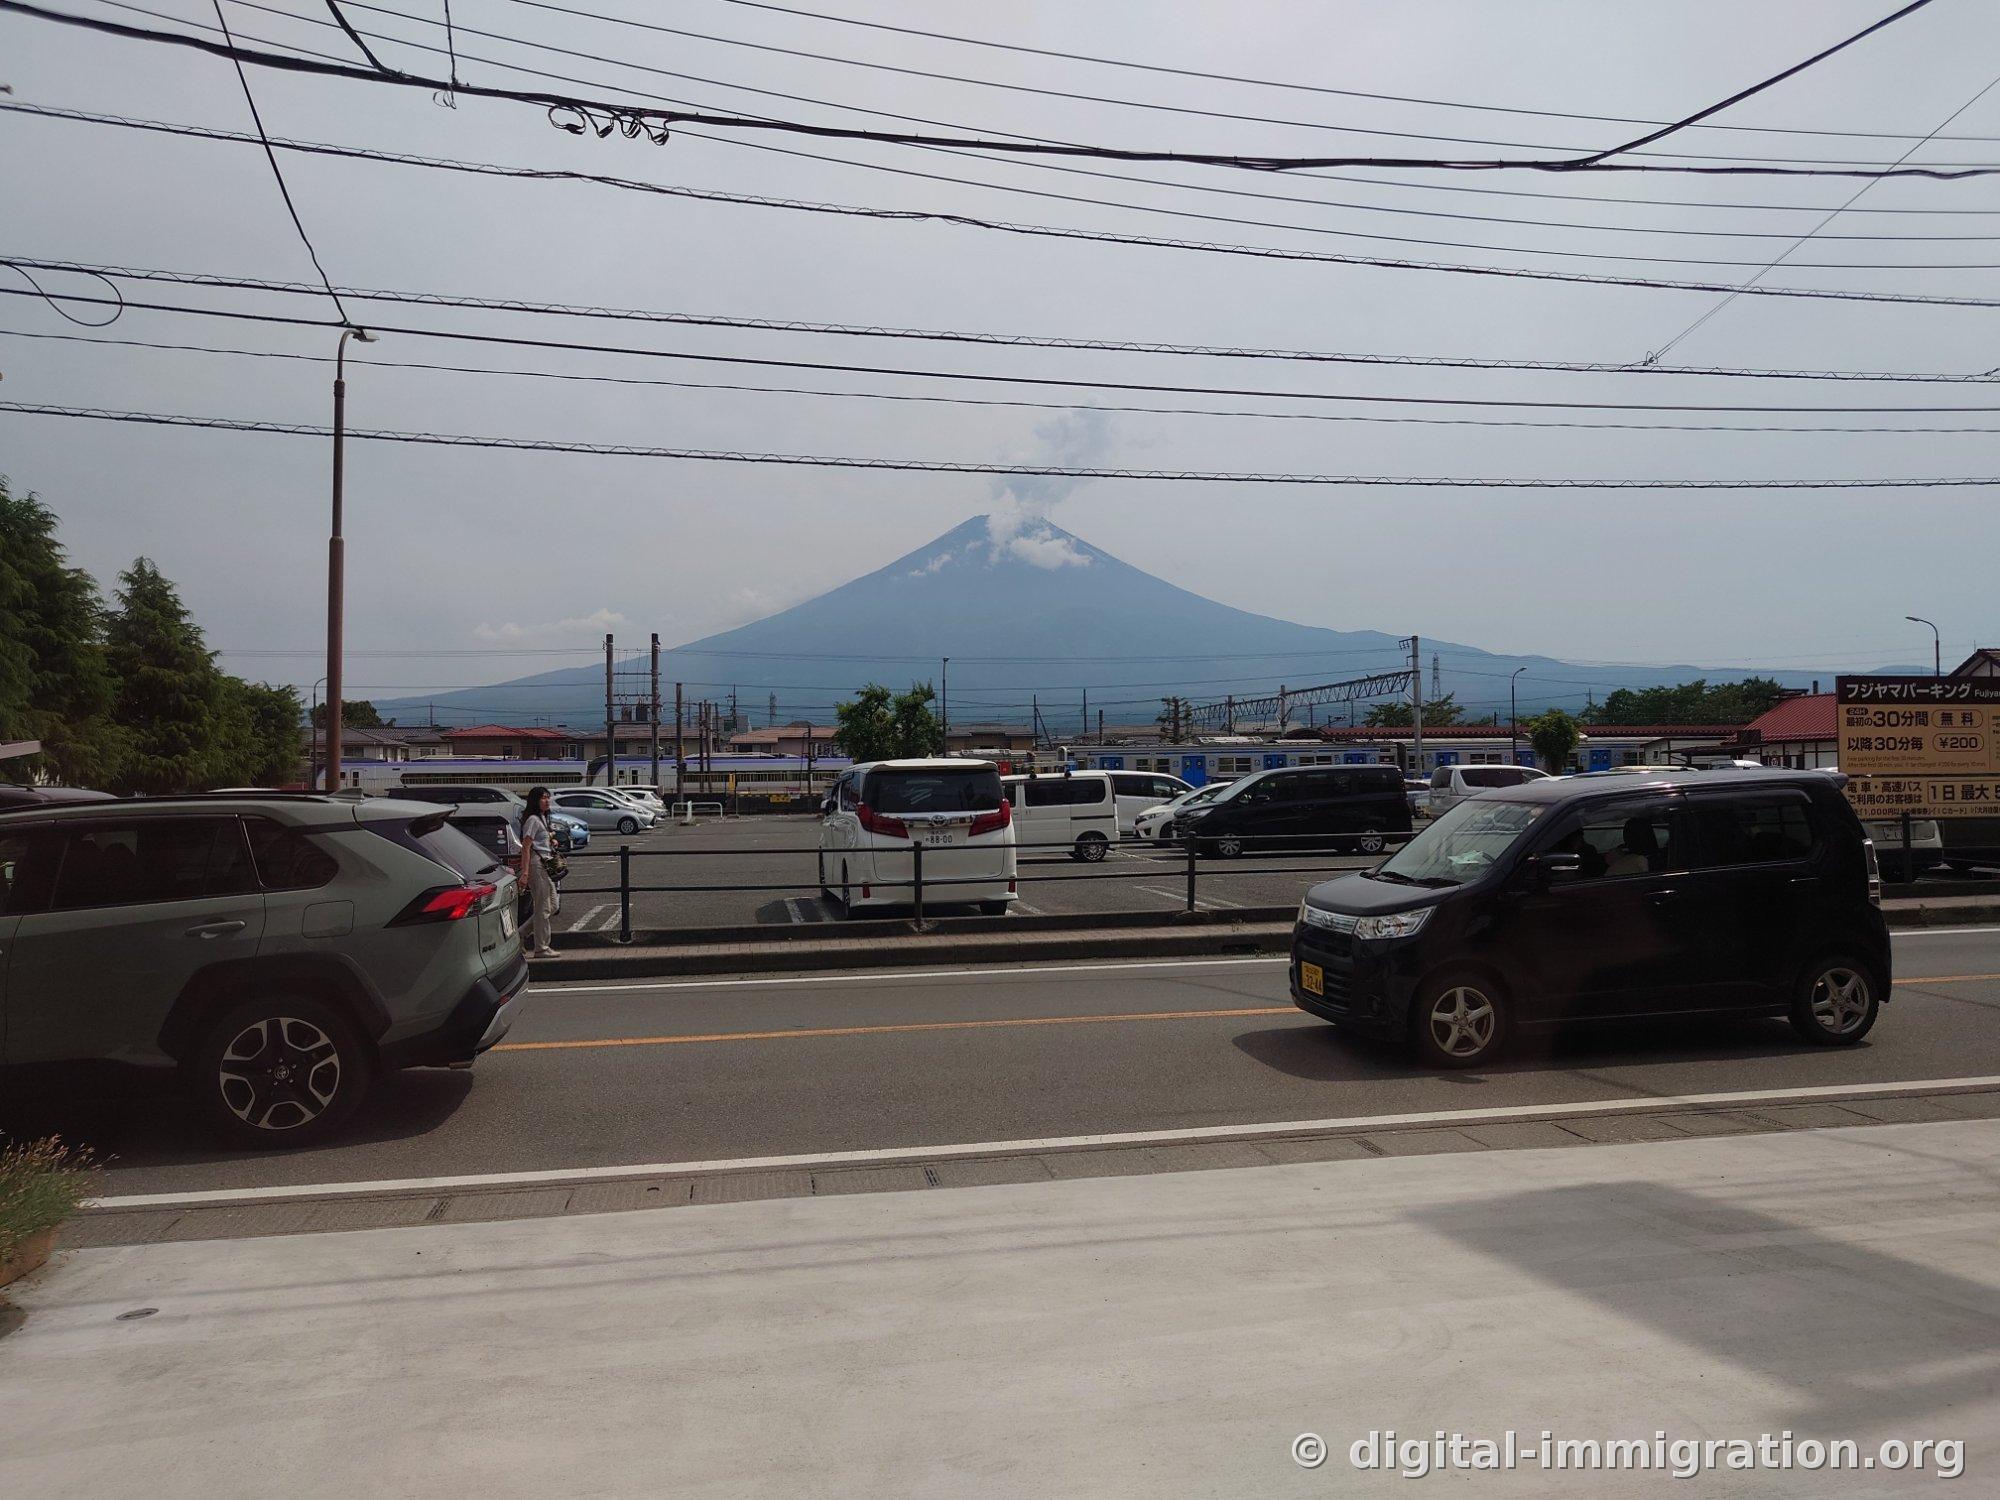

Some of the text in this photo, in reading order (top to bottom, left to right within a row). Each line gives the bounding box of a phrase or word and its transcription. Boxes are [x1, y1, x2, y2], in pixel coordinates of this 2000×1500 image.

[1846, 682, 1972, 699] フジヤマパーキング
[1847, 736, 1978, 751] 以降30分毎 ¥200
[1848, 794, 1922, 806] ご利用のお客様は
